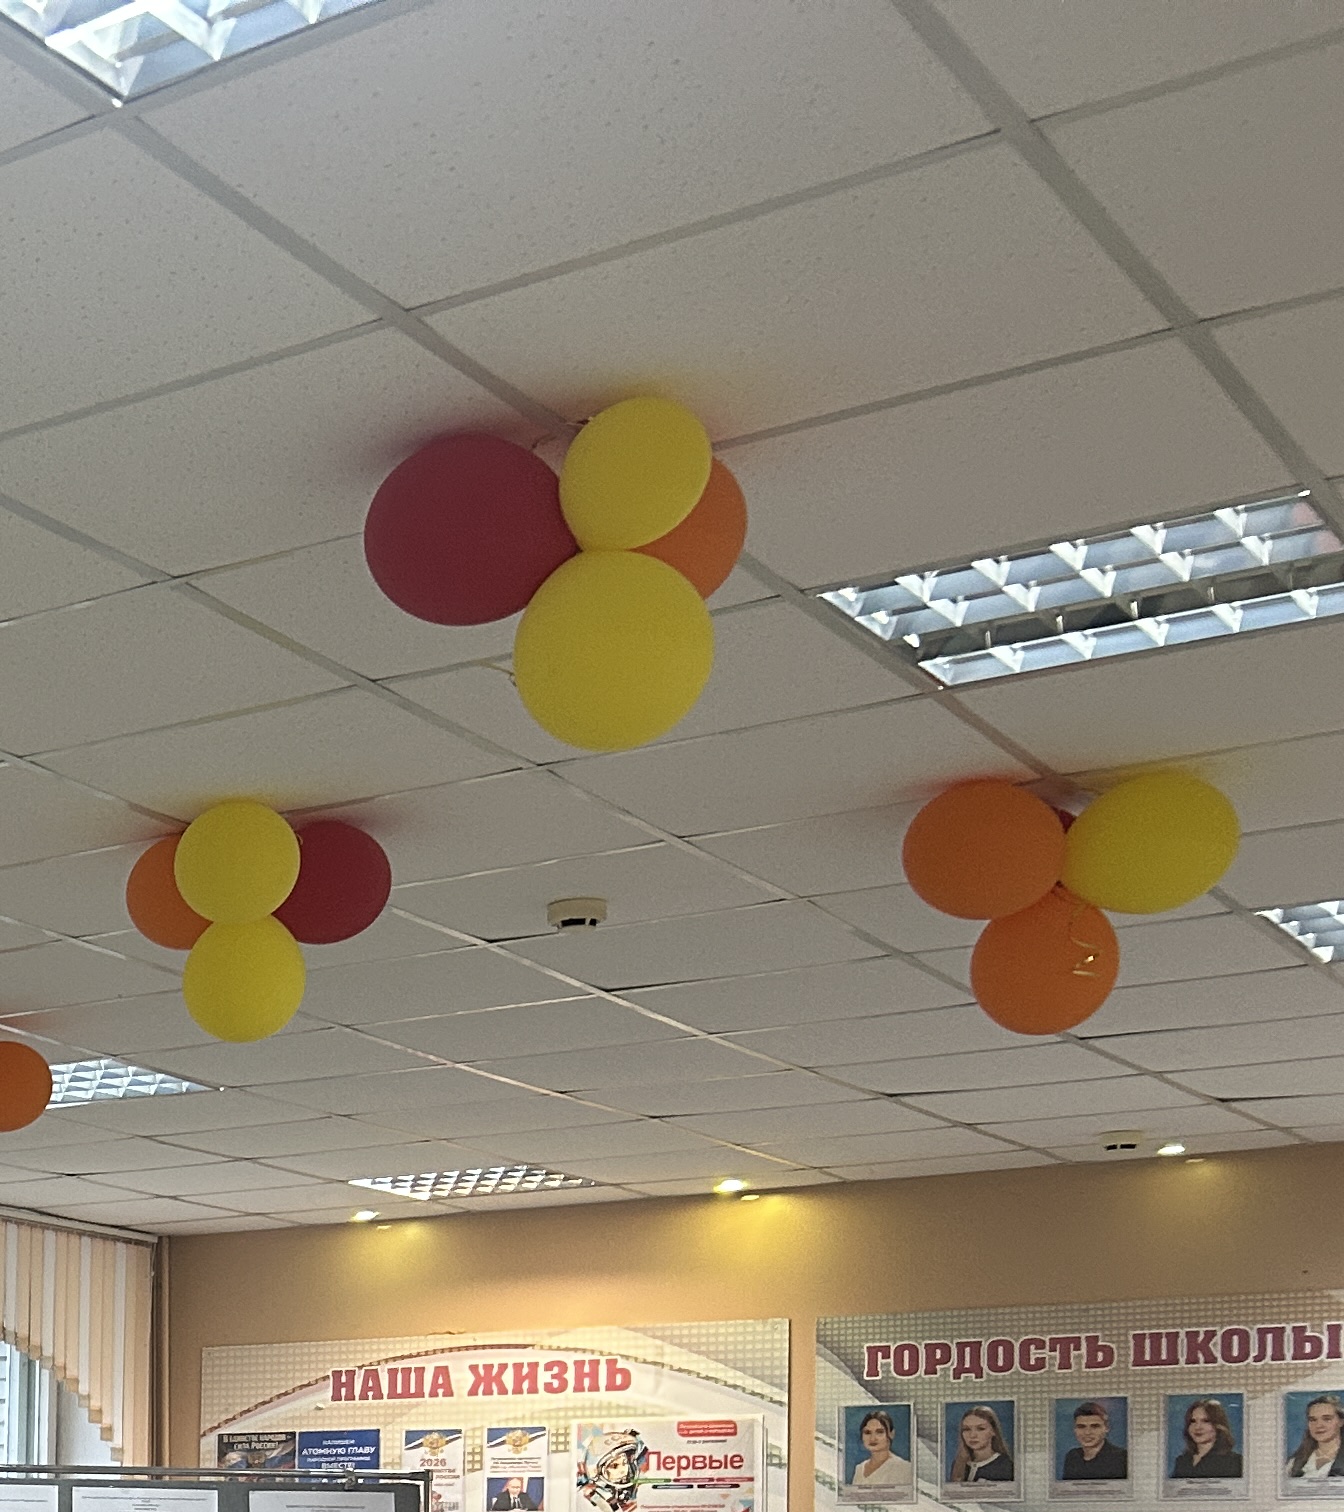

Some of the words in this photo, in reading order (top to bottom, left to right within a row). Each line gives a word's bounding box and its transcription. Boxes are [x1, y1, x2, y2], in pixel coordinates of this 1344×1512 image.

[864, 1335, 1115, 1380] ГОРДОСТЬ
[1131, 1323, 1343, 1367] ШКОЛЫ
[330, 1366, 454, 1402] НАША
[467, 1358, 632, 1397] ЖИЗНЬ
[302, 1447, 347, 1456] АТОМНУЮ
[348, 1446, 377, 1454] ГЛАВУ
[419, 1458, 447, 1468] 2026
[646, 1451, 745, 1477] Первые
